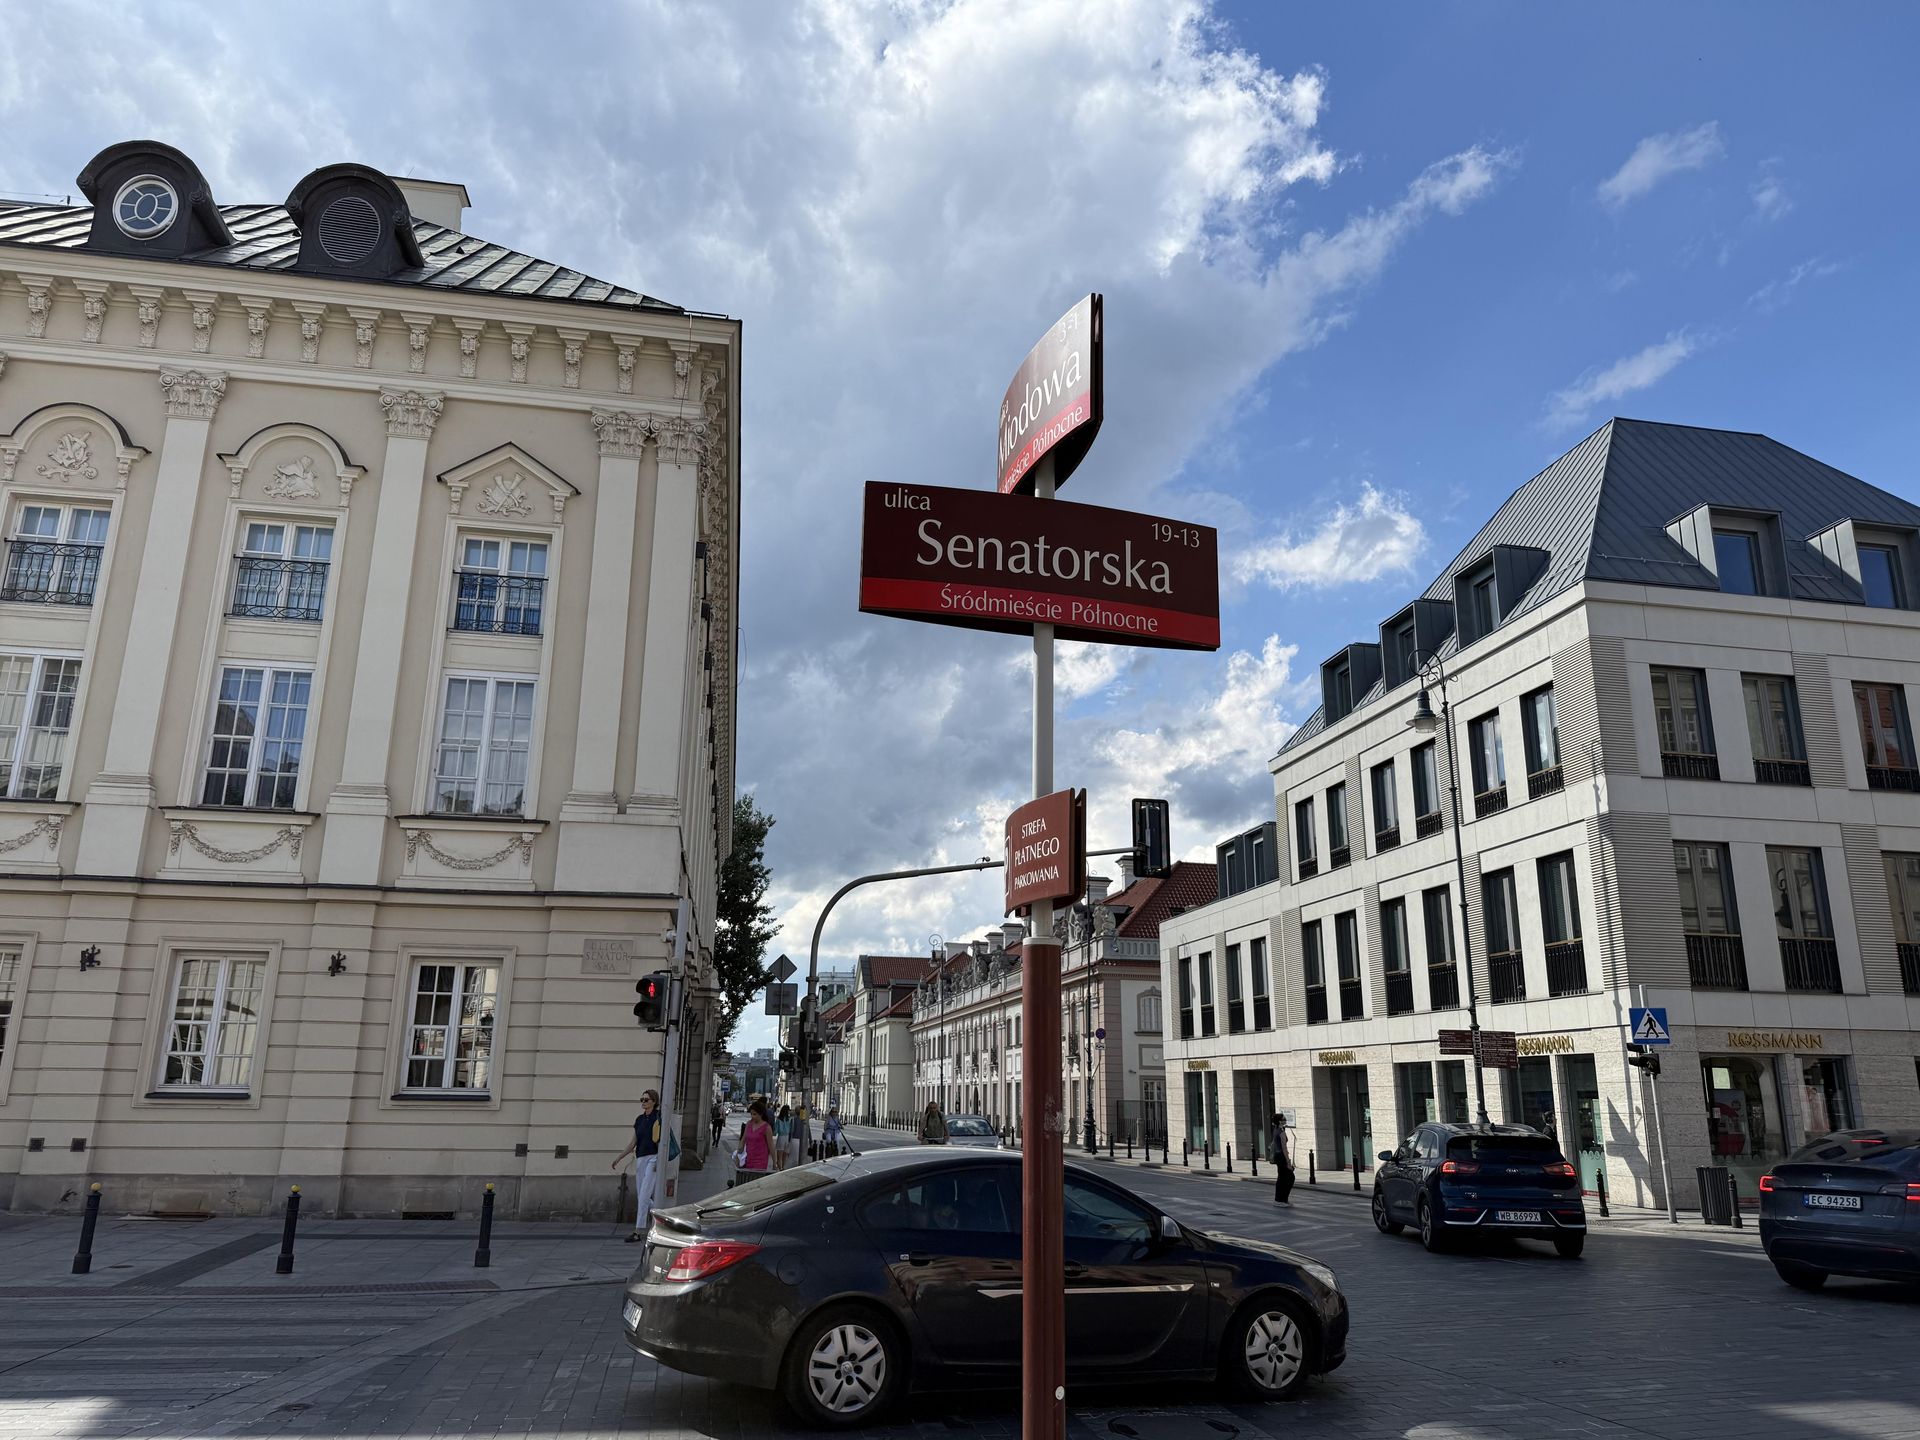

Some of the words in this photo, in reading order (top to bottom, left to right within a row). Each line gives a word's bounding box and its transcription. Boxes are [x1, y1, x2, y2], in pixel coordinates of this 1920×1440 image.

[1032, 406, 1083, 459] Północne
[884, 487, 931, 511] ulica
[1151, 522, 1200, 548] 19-13
[916, 518, 1174, 594] Senatorska
[940, 583, 1063, 620] Śródmieście
[1071, 601, 1159, 632] Północne
[1021, 817, 1047, 839] STREFA
[1014, 836, 1060, 868] PŁATNEGO
[1014, 865, 1059, 890] PARKOWANIA
[1727, 1032, 1823, 1049] ROSSMANN
[1811, 1195, 1823, 1205] EC
[1826, 1196, 1858, 1207] 94258
[1513, 1212, 1540, 1221] 8699X
